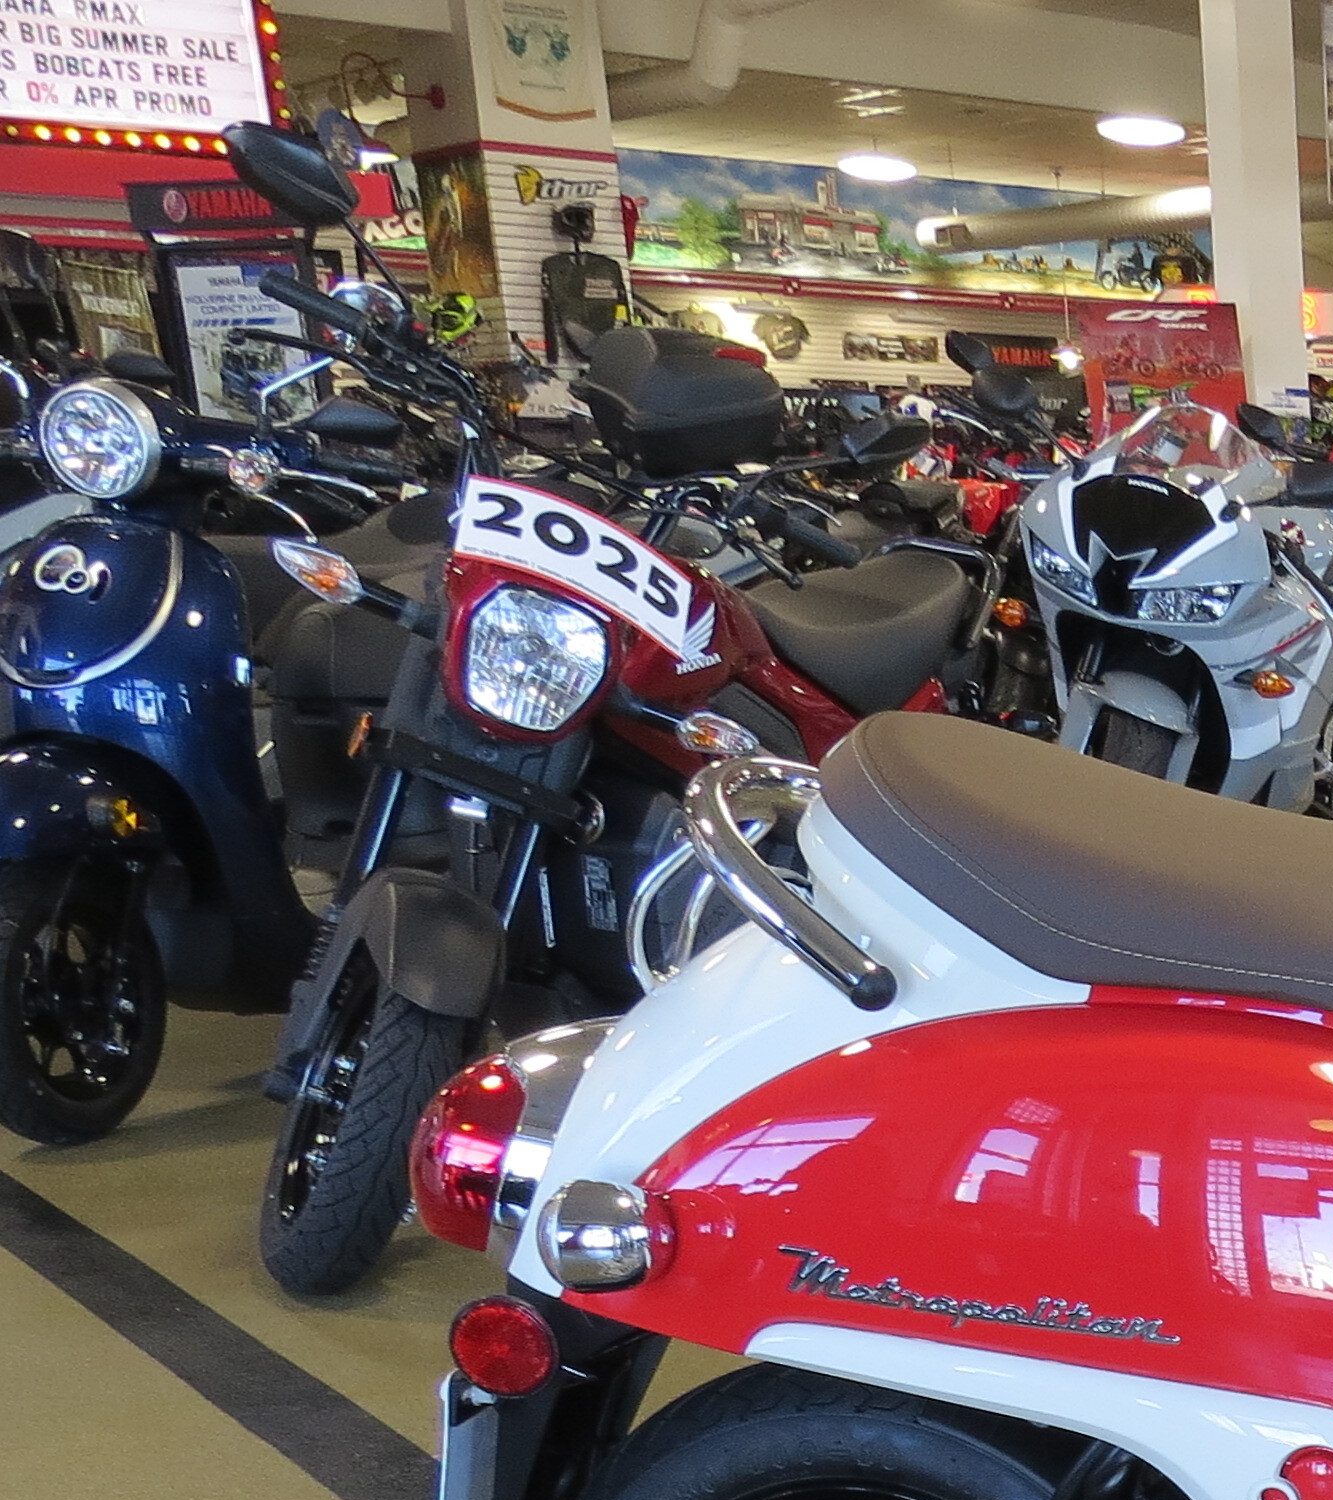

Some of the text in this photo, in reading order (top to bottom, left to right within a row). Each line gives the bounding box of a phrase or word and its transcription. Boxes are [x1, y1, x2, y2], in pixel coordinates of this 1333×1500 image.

[75, 0, 144, 26] RMAX
[19, 22, 62, 47] BIG
[71, 27, 169, 57] SUMMER
[183, 38, 240, 63] SALE
[34, 52, 142, 83] BOBCATS
[152, 61, 208, 88] FREE
[26, 80, 59, 105] 0%
[74, 85, 120, 110] APR
[133, 90, 213, 117] PROMO
[992, 345, 1053, 367] YAMAHA
[472, 492, 681, 619] 2025
[675, 652, 722, 675] HONDA
[777, 1243, 1182, 1345] Metropolitan
